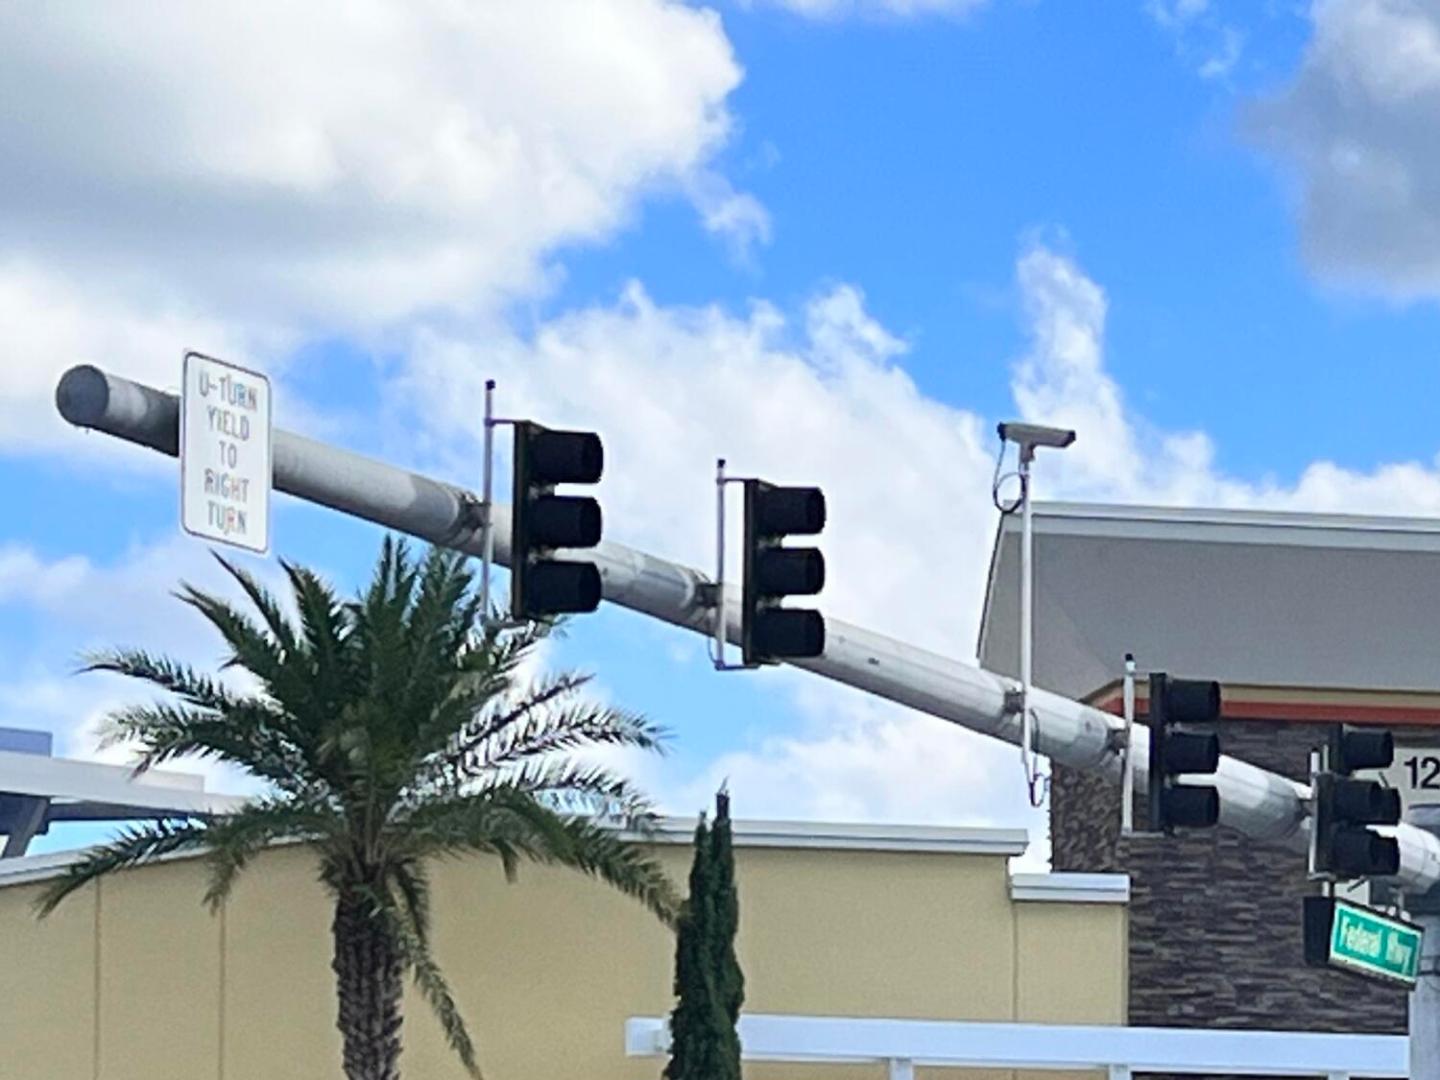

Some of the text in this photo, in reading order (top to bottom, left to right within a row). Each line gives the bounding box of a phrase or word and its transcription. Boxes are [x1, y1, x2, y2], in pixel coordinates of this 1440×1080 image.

[198, 371, 258, 411] U-TURN
[207, 405, 250, 441] YIELD
[218, 441, 238, 469] TO
[204, 468, 250, 504] RIGHT
[208, 500, 247, 535] TURN
[1339, 915, 1383, 958] Federal
